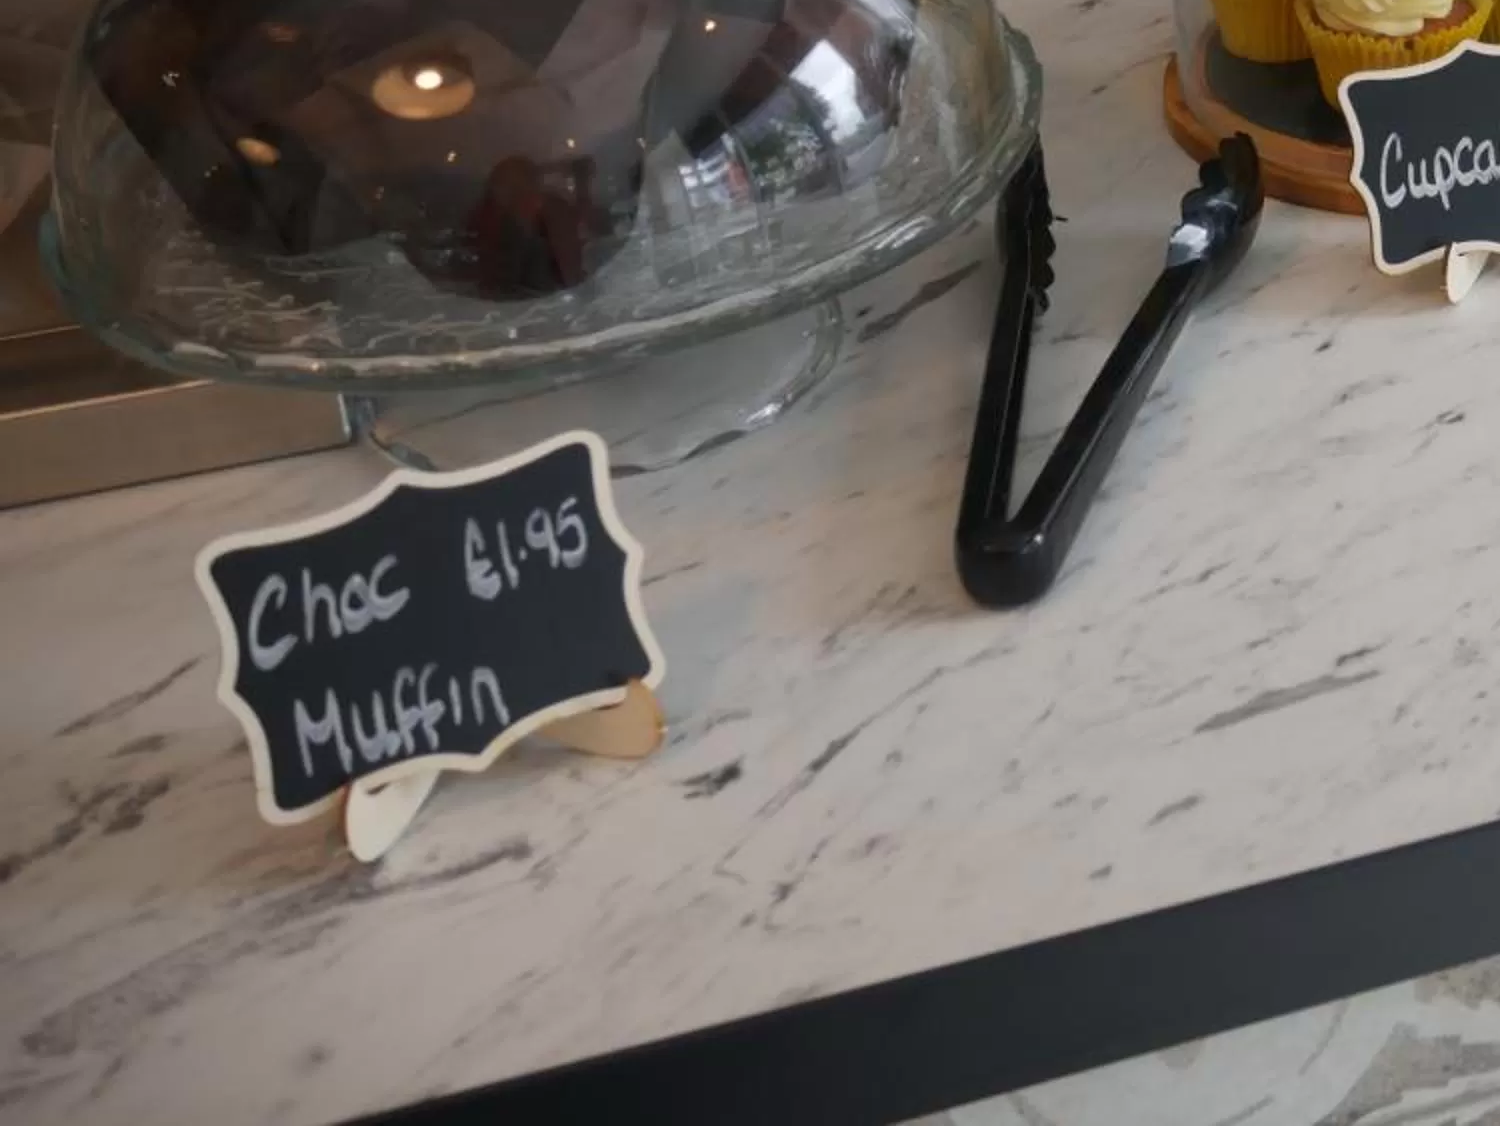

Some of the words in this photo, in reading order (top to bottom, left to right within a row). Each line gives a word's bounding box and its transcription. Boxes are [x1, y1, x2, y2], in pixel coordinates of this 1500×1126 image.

[247, 553, 411, 672] Choc
[463, 495, 589, 602] £1.95
[293, 661, 511, 778] Muffin
